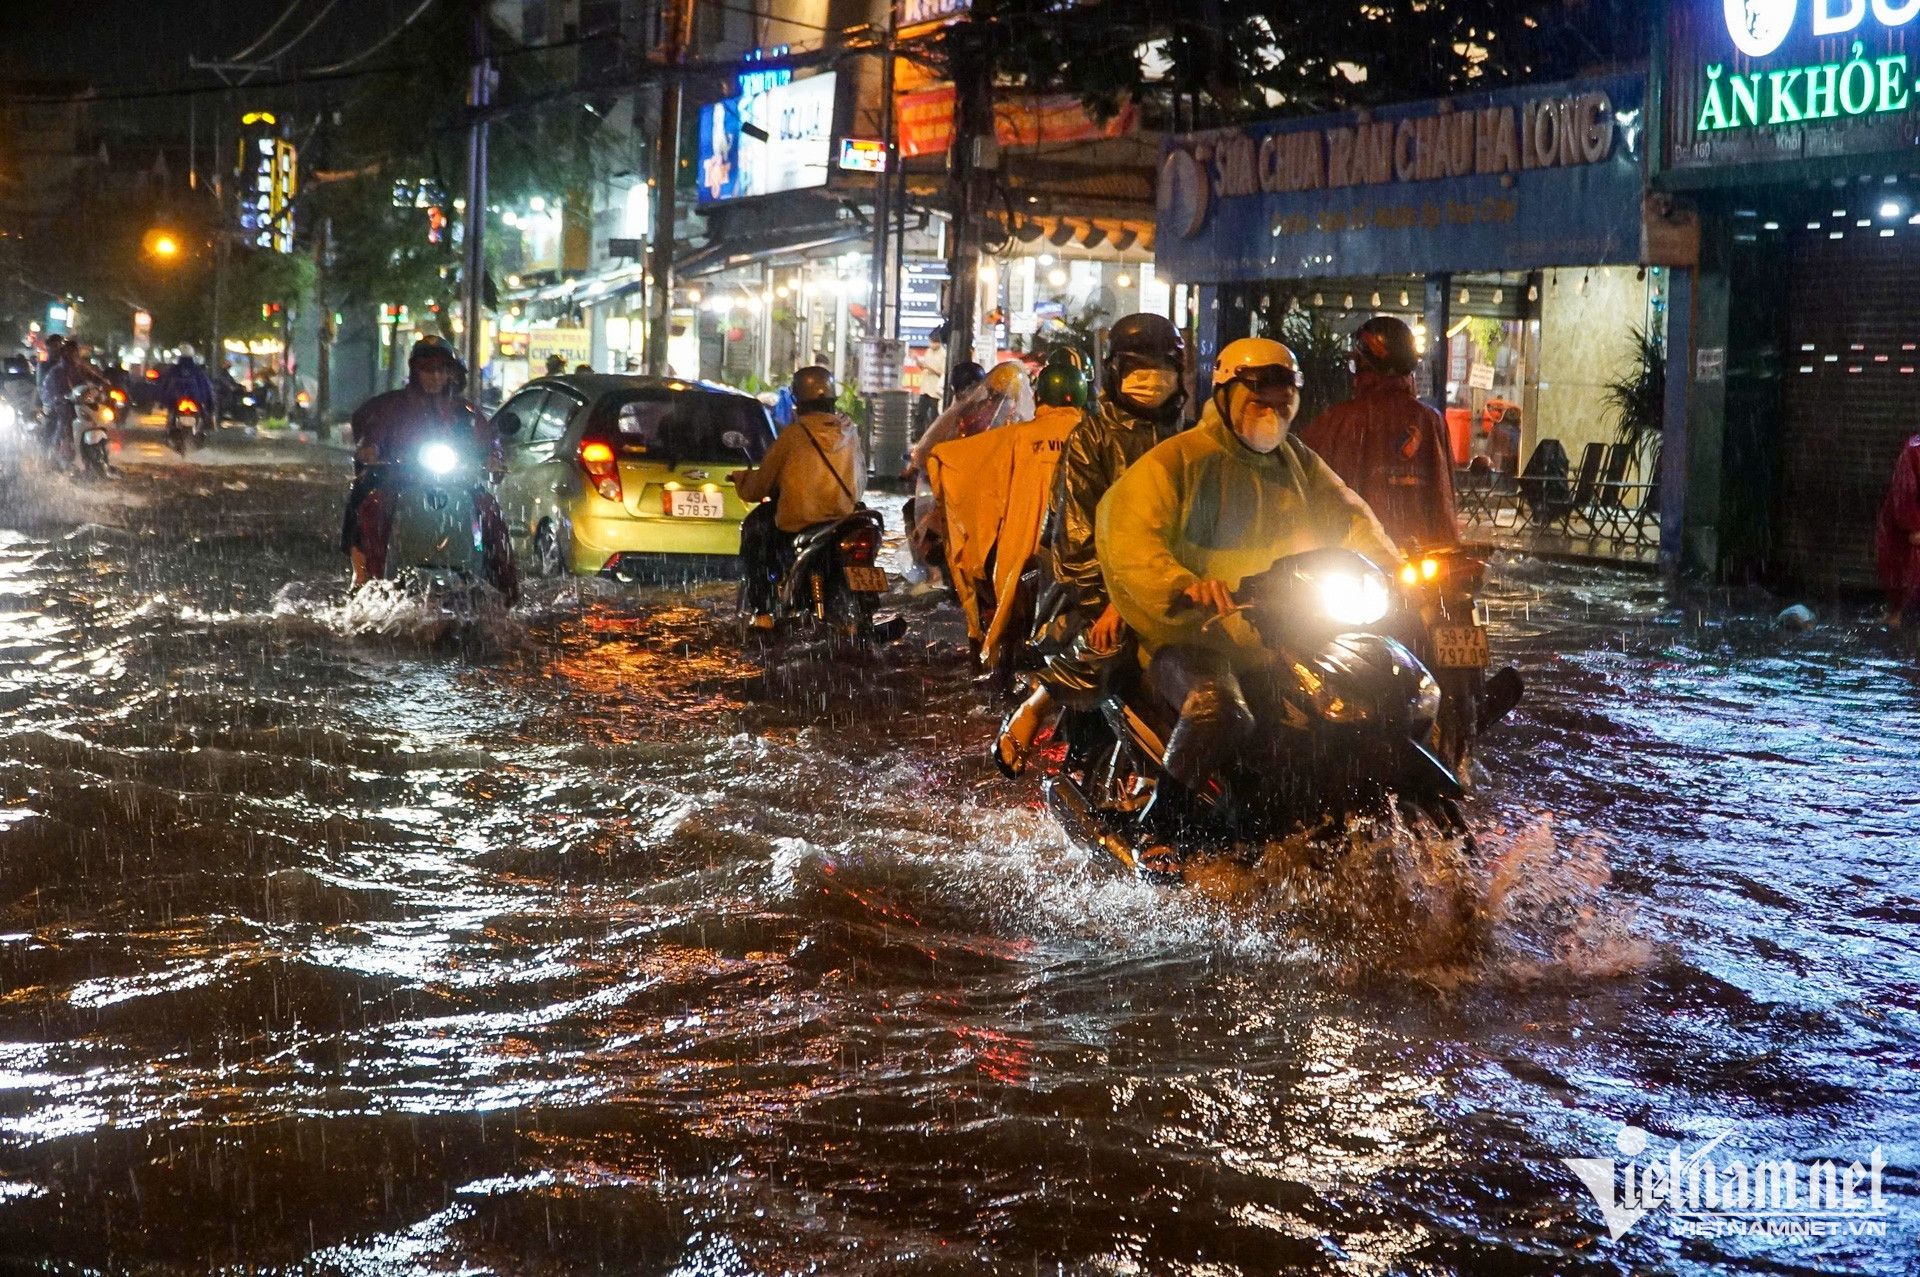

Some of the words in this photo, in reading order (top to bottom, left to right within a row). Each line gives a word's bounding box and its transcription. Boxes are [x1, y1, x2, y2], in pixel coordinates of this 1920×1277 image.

[1697, 63, 1762, 131] ĂN
[1767, 40, 1909, 125] KHỎE
[1521, 91, 1614, 173] LONG
[677, 504, 718, 517] 578.57
[686, 492, 708, 504] 49A
